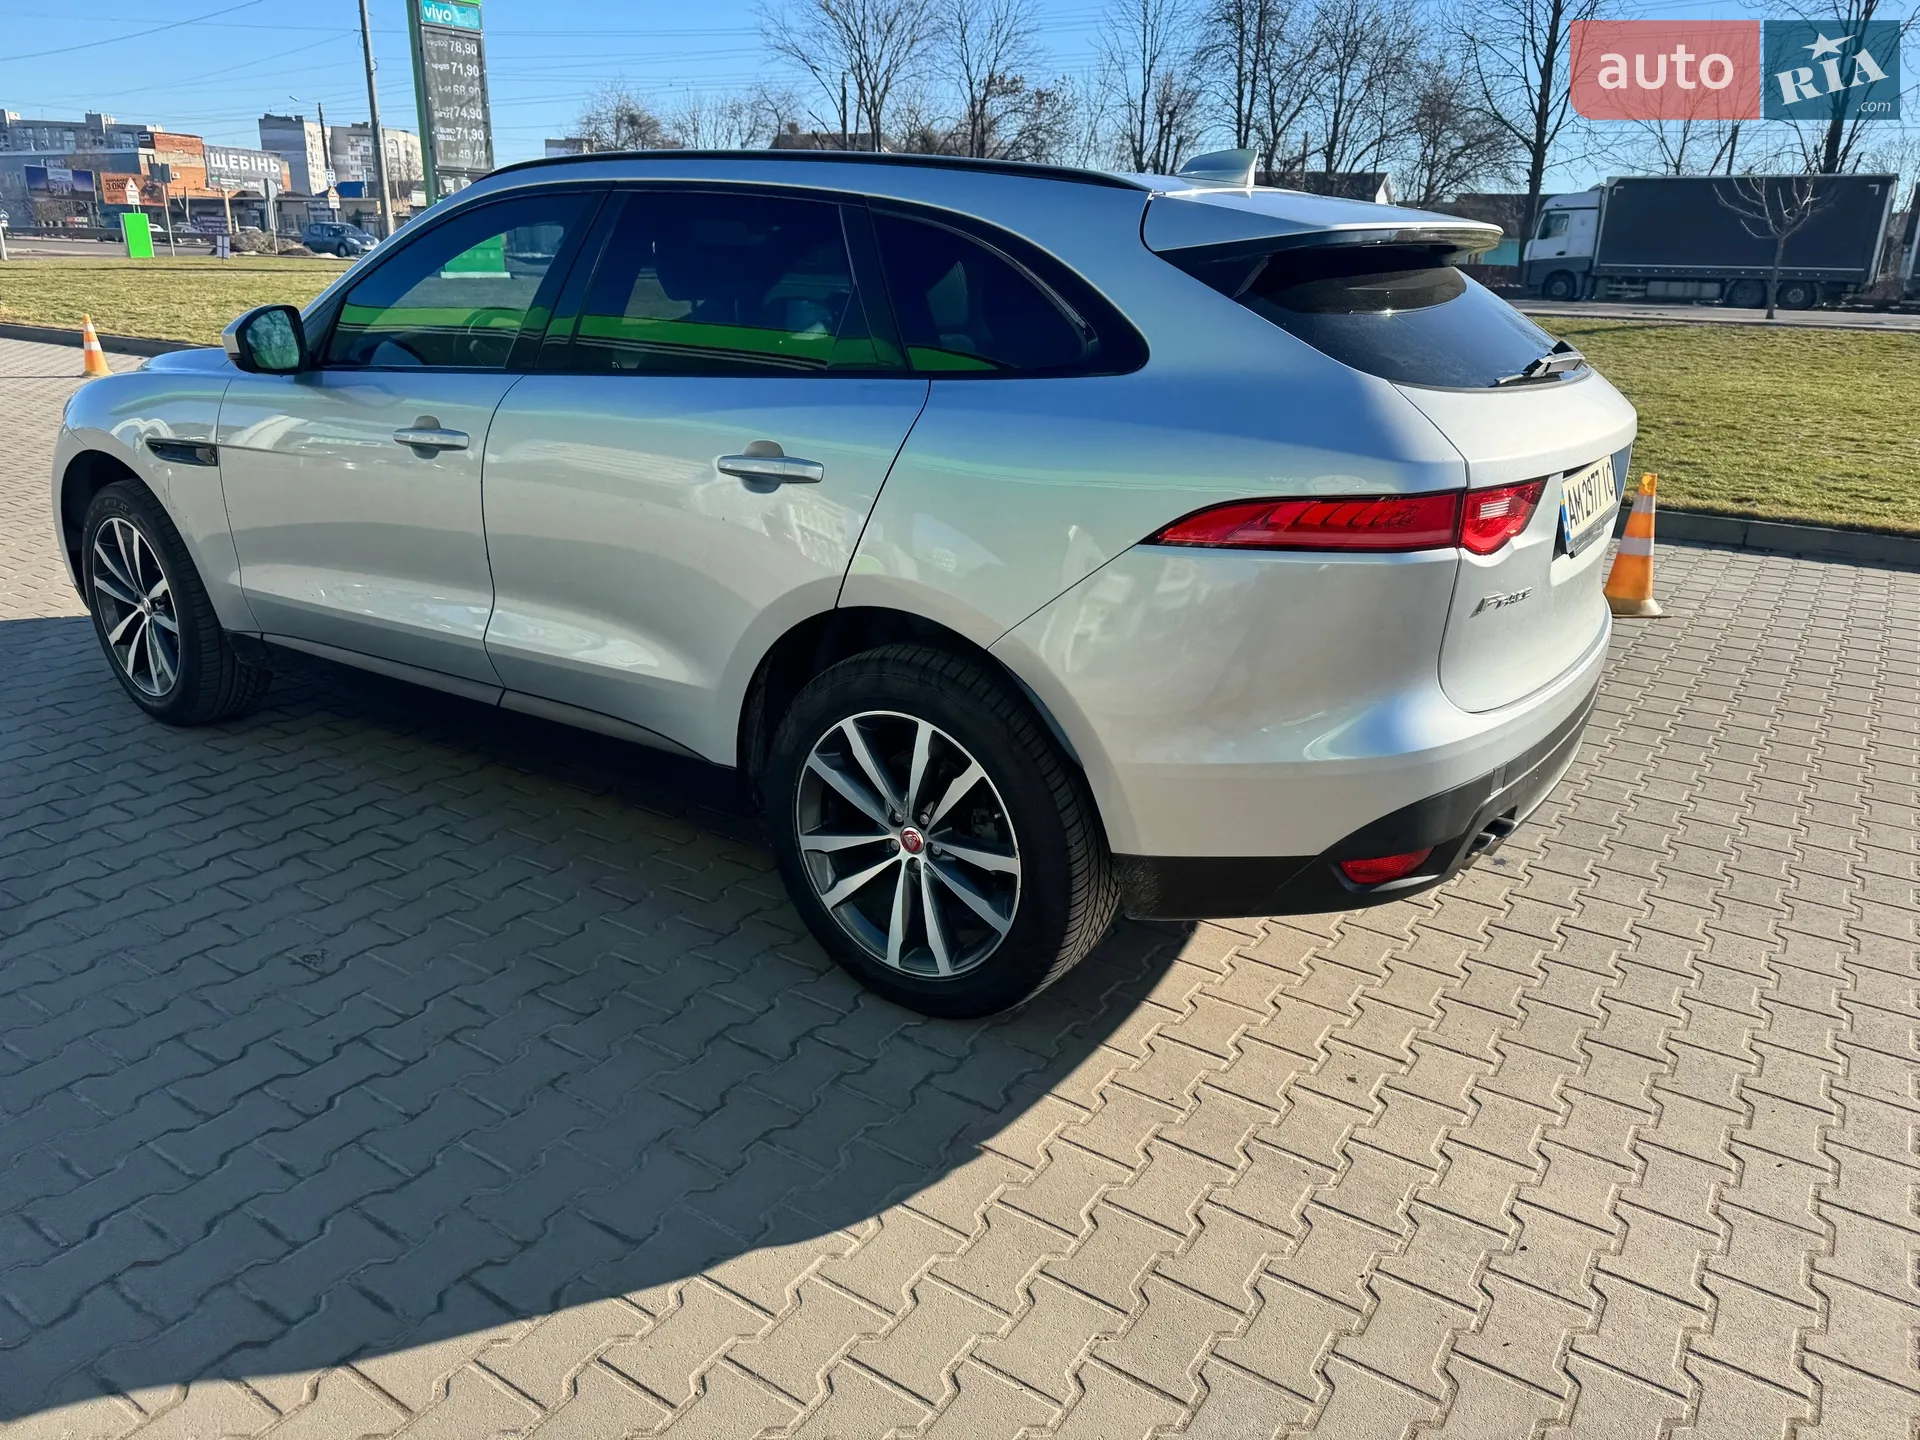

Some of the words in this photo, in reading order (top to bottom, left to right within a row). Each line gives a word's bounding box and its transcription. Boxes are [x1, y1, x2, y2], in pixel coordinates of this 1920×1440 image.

[424, 4, 452, 21] vivo
[449, 40, 478, 56] 78,90
[450, 61, 480, 78] 71,90
[454, 106, 483, 120] 74,90
[455, 126, 485, 142] 71,90
[210, 153, 280, 173] ЩЕБІНЬ
[1567, 484, 1585, 530] AM
[1582, 470, 1602, 518] 2977
